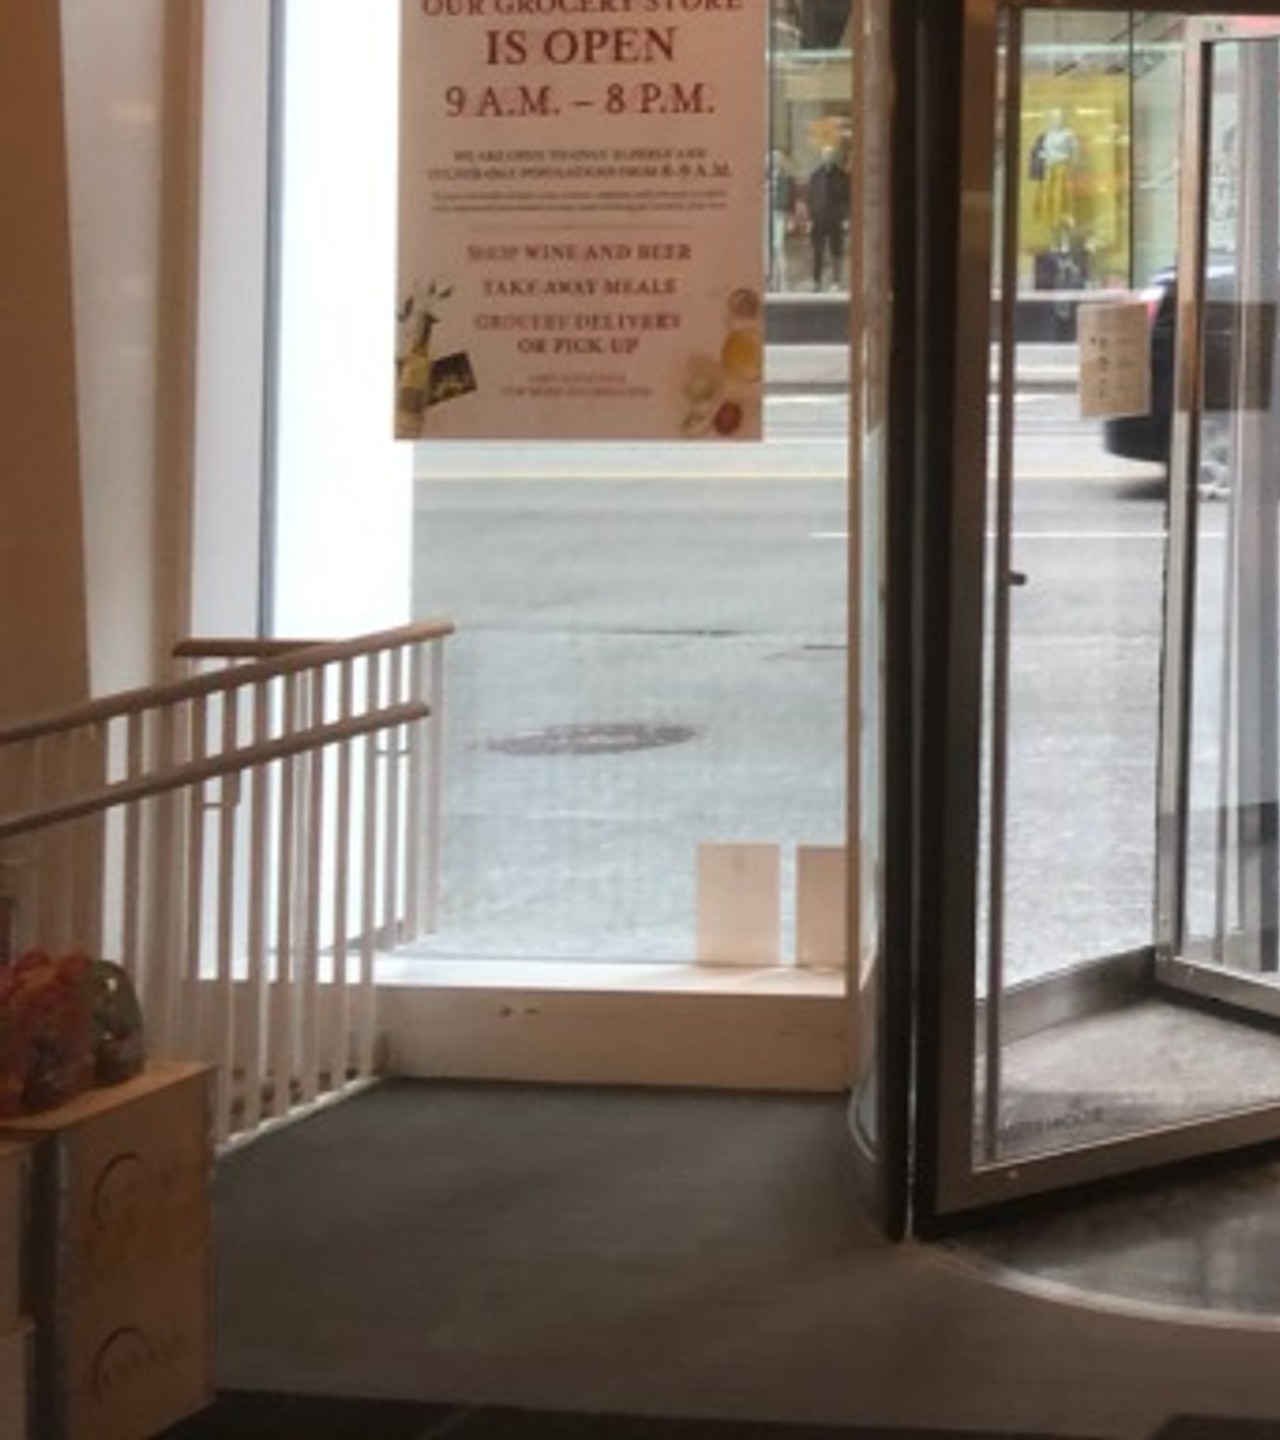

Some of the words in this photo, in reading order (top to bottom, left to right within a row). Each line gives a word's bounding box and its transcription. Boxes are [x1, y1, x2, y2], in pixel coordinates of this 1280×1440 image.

[486, 29, 528, 66] IS
[543, 25, 678, 65] OPEN
[445, 85, 467, 118] 9
[476, 85, 560, 117] A.M.
[605, 82, 626, 114] 8
[639, 81, 715, 114] P.M.
